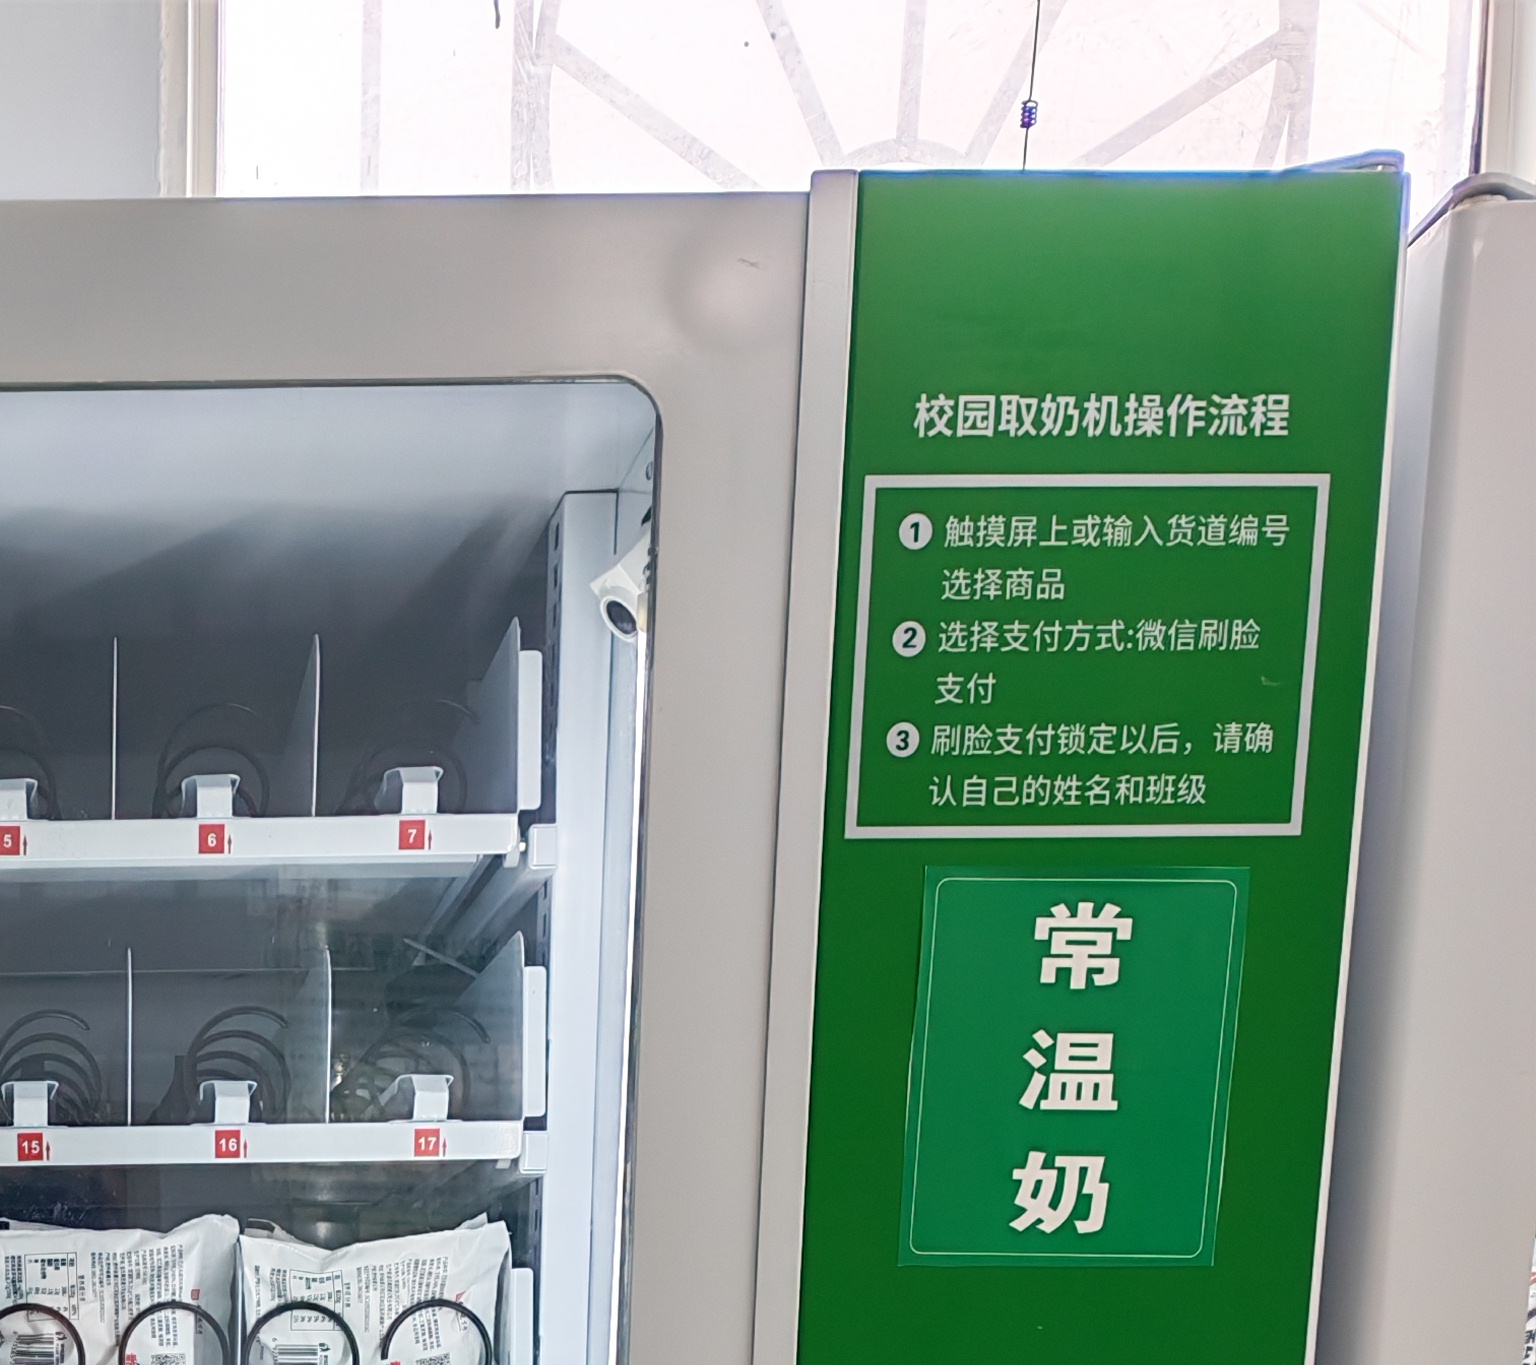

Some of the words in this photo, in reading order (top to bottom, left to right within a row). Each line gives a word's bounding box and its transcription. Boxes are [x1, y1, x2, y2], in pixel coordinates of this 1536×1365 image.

[913, 392, 1291, 439] 校园取奶机操作流程
[943, 514, 1291, 548] 触摸屏上或输入货道编号
[940, 568, 1066, 601] 选择商品
[937, 619, 1261, 654] 选择支付方式:微信刷脸
[933, 673, 997, 706] 支付
[930, 722, 1275, 758] 刷脸支付锁定以后，请确
[928, 773, 1207, 807] 认自己的姓名和班级
[3, 833, 12, 848] 5
[207, 832, 217, 847] 6
[407, 828, 417, 844] 7
[1008, 901, 1134, 1235] 常温奶
[21, 1140, 40, 1154] 15
[219, 1137, 238, 1152] 16
[418, 1136, 437, 1151] 17
